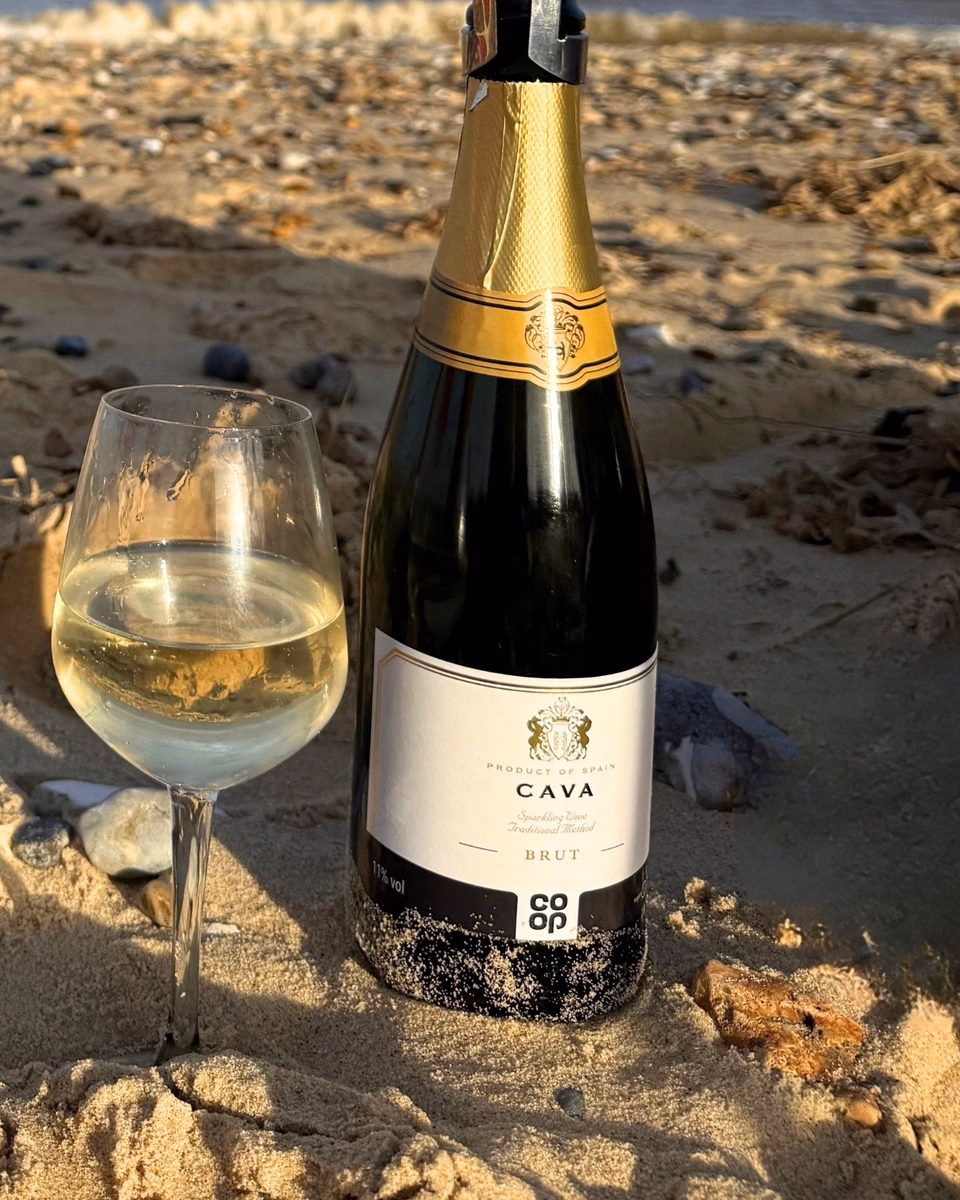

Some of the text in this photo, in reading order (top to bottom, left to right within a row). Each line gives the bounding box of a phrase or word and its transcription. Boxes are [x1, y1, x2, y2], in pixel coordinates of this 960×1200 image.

[486, 762, 552, 776] PRODUCT
[582, 763, 616, 774] SPAIN
[516, 782, 594, 799] CAVA
[517, 810, 588, 822] Sparkling Wine
[507, 821, 597, 834] Traditional Method
[524, 849, 580, 861] BRUT
[372, 860, 405, 895] 11% vol
